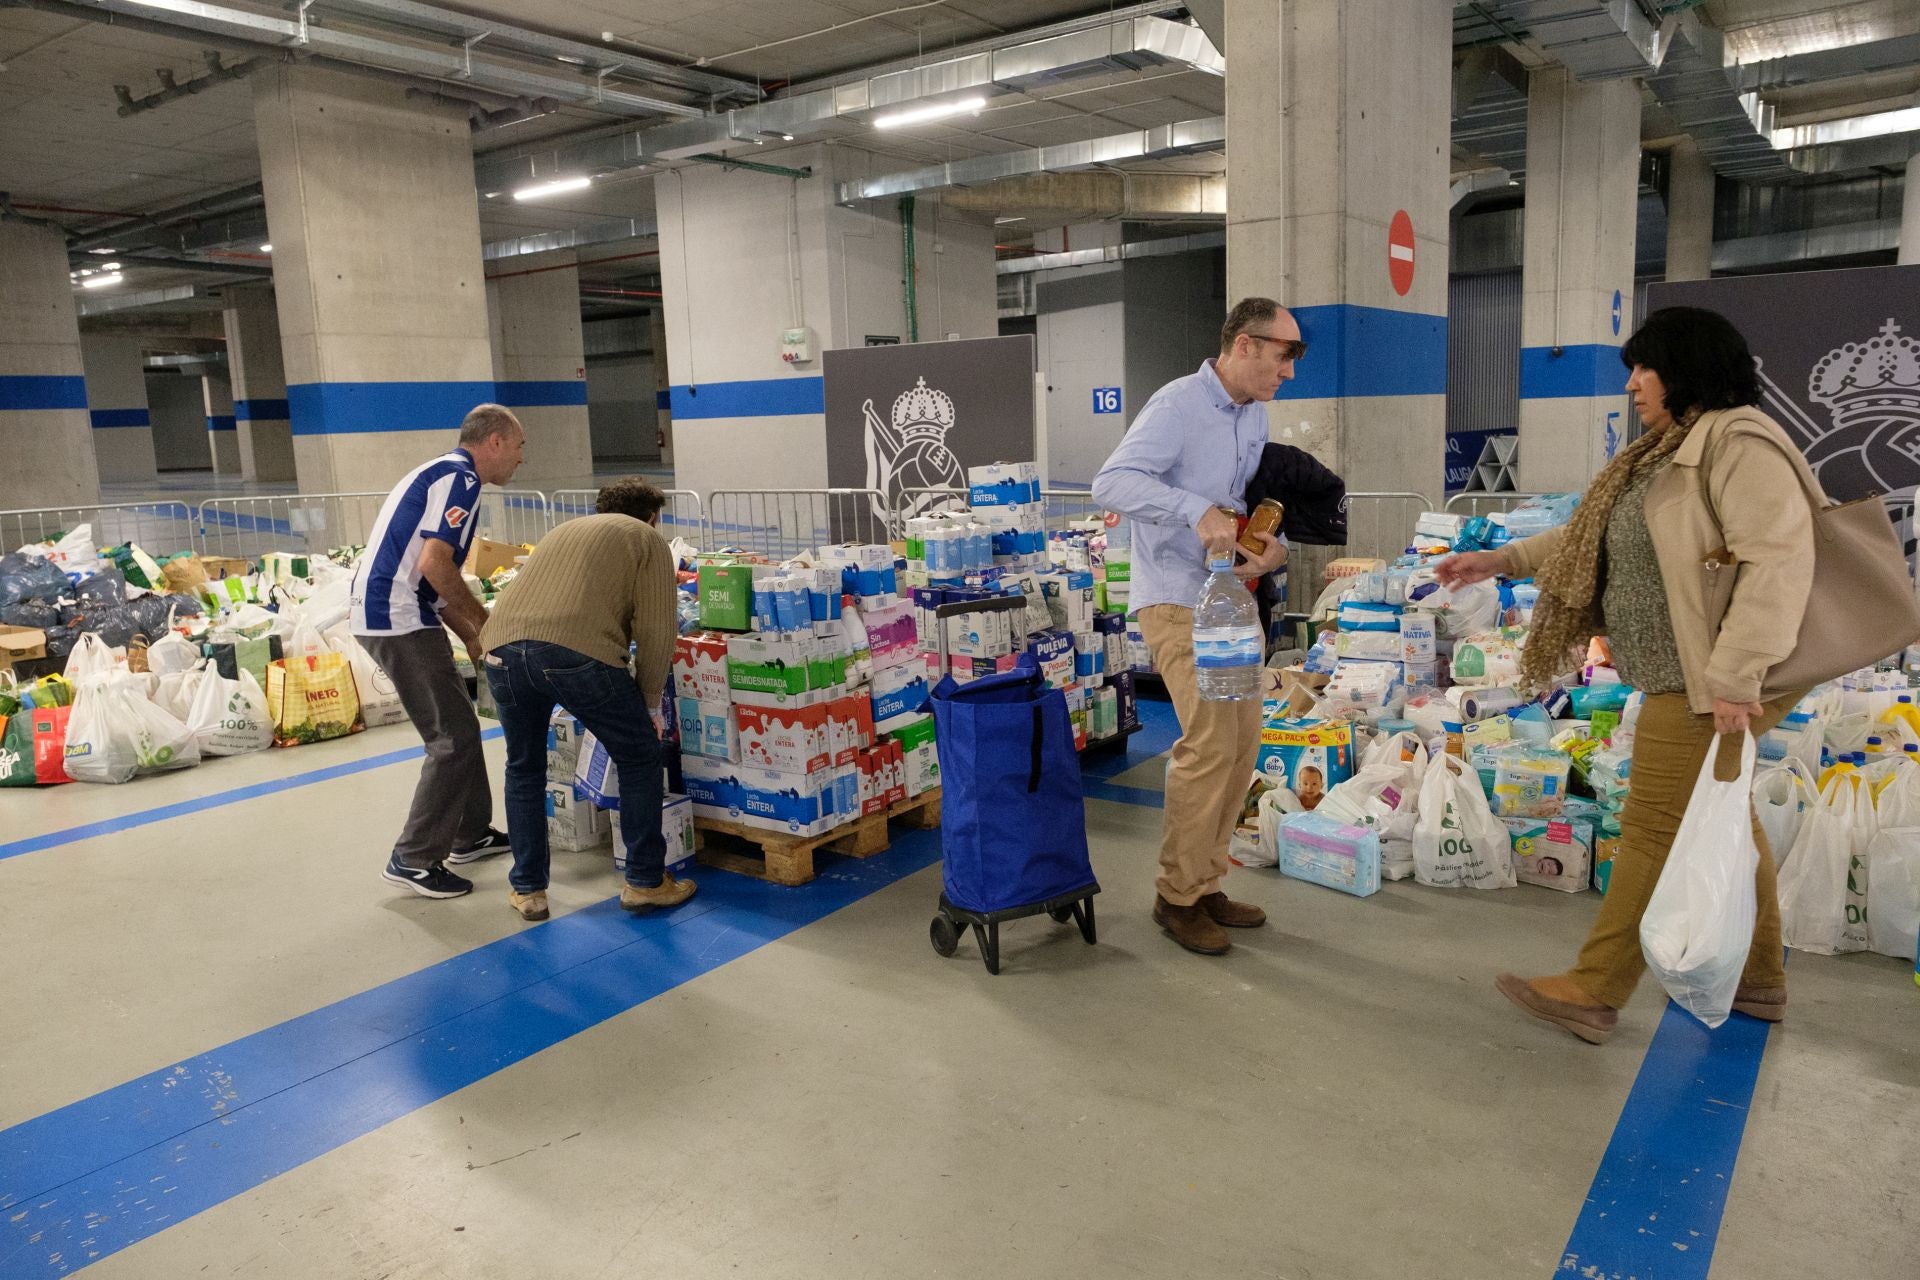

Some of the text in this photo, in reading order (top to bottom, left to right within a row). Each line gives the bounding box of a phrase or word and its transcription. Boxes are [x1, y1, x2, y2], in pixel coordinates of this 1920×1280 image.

[1096, 391, 1117, 410] 16
[973, 494, 997, 503] ENTERA
[709, 591, 729, 601] SEMI
[870, 634, 881, 643] Sin
[1403, 630, 1432, 639] NATIVA
[871, 640, 890, 650] Lactosa
[1037, 637, 1068, 656] PULEVA
[1068, 656, 1073, 666] 3
[702, 673, 725, 685] ENTERA
[732, 674, 788, 689] SEMIDESNATADA
[878, 701, 904, 716] ENTERA
[219, 719, 258, 731] 100%
[1262, 733, 1283, 741] MEGA
[774, 740, 795, 748] ENTERA
[1266, 763, 1283, 772] Baby
[686, 787, 715, 801] ENTERA
[746, 799, 775, 814] ENTERA
